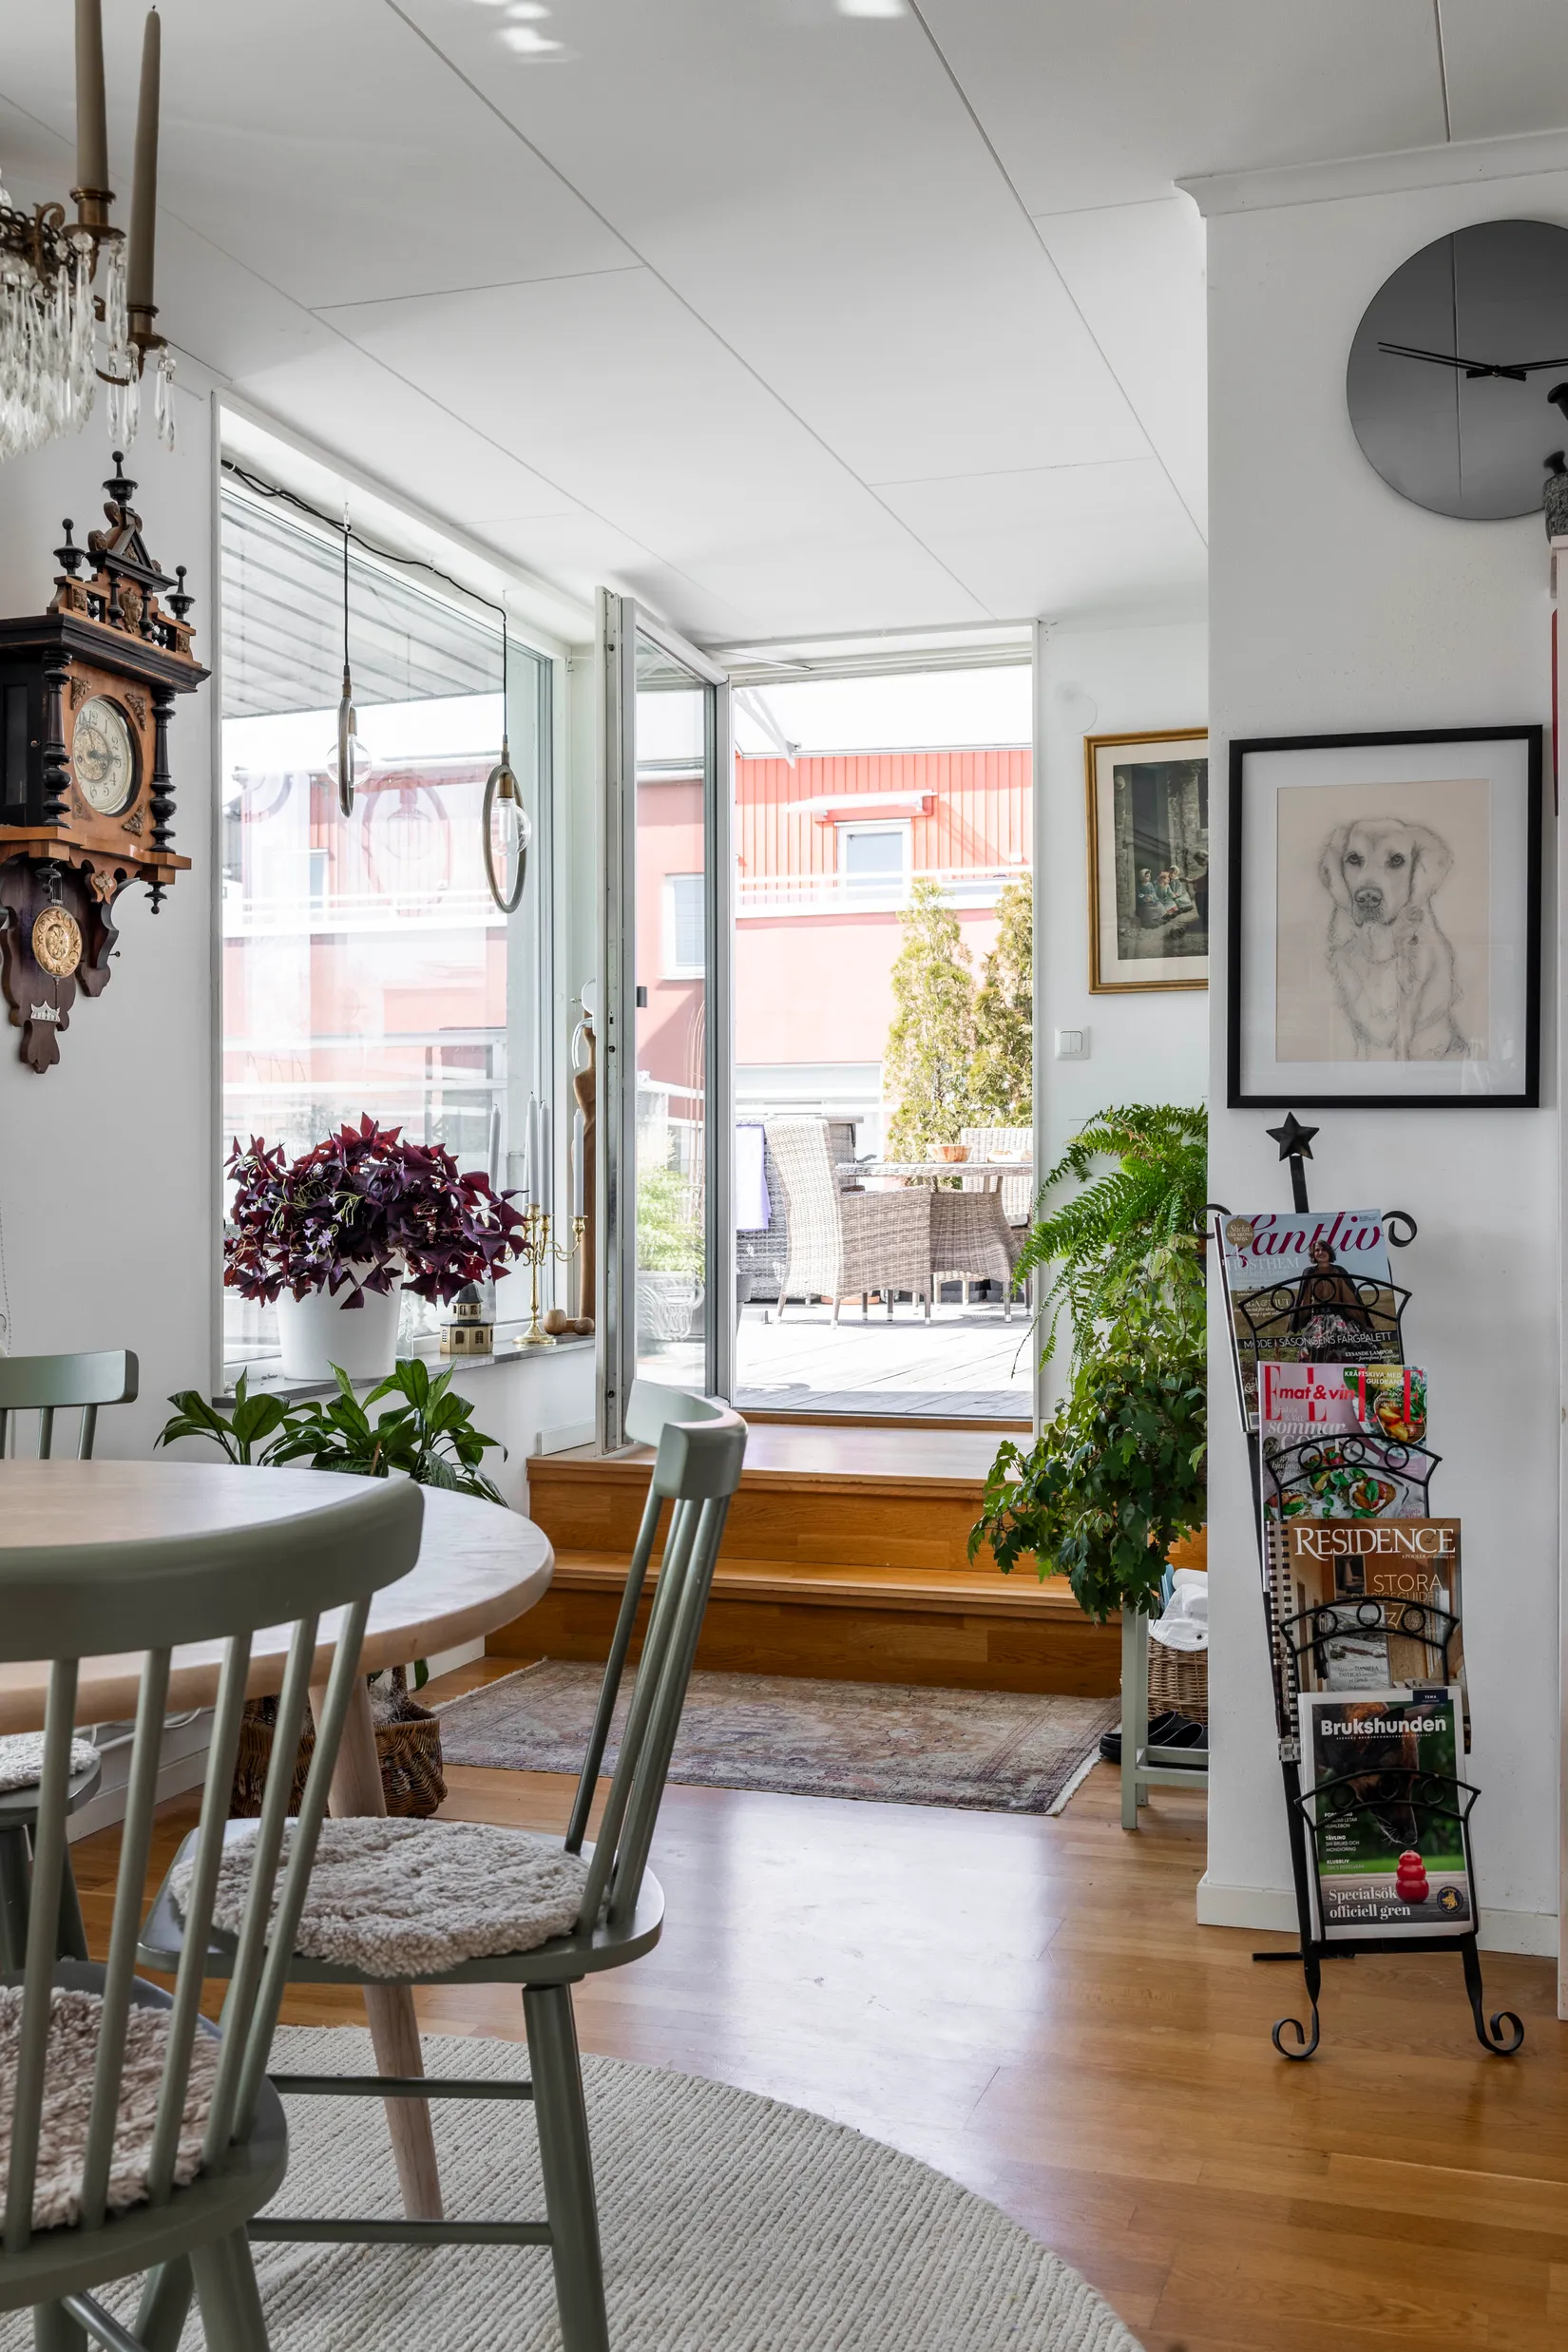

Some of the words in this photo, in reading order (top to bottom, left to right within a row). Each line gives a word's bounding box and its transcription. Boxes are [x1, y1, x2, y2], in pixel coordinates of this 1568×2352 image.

[88, 710, 98, 726] 12
[111, 736, 119, 750] 2
[109, 772, 116, 786] 4
[103, 783, 109, 796] 5
[1226, 1212, 1385, 1268] Lantliv
[1243, 1338, 1273, 1348] MODE
[1279, 1333, 1336, 1348] SÄSONGENS
[1337, 1330, 1392, 1345] FÄRGPALETT
[1263, 1366, 1424, 1424] ELLE
[1279, 1386, 1311, 1400] mat
[1313, 1385, 1327, 1401] &
[1329, 1384, 1356, 1401] vin
[1268, 1421, 1348, 1435] sommar-
[1293, 1527, 1456, 1561] RESIDENCE
[1373, 1574, 1444, 1593] STORA
[1321, 1716, 1446, 1736] Brukshunden
[1329, 1885, 1398, 1904] Specialsök
[1329, 1903, 1378, 1919] officiell
[1380, 1905, 1411, 1920] gren
